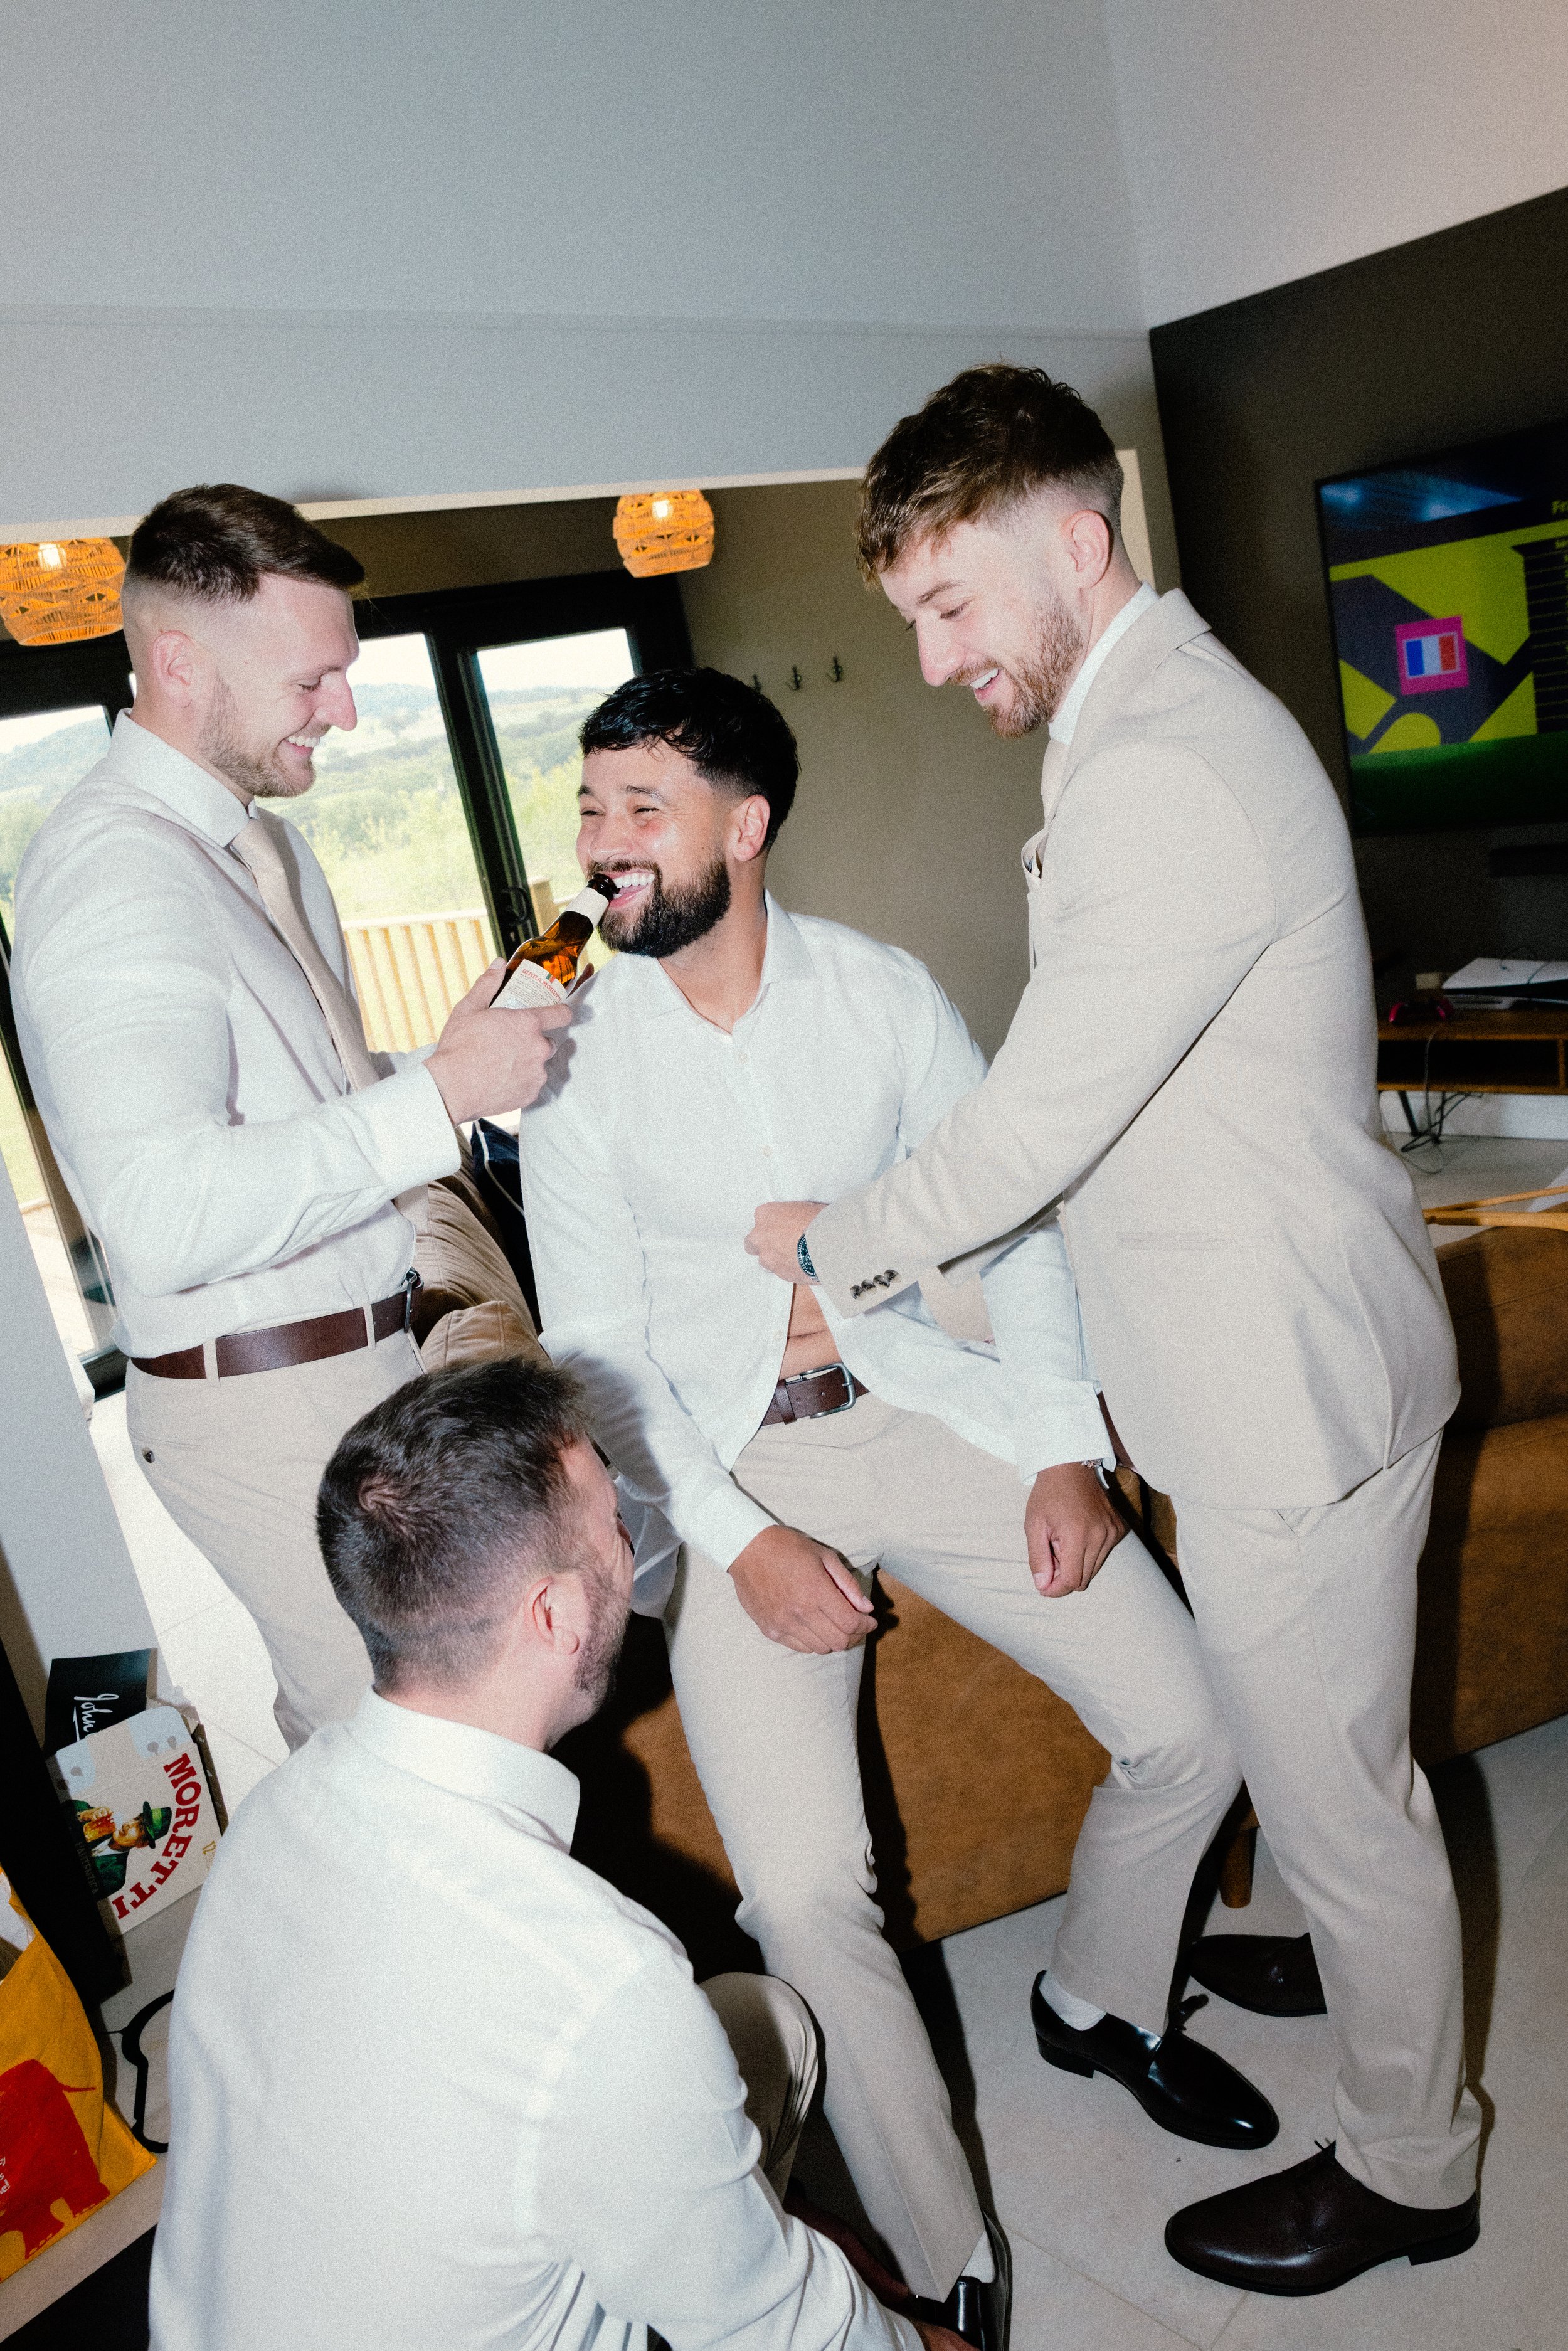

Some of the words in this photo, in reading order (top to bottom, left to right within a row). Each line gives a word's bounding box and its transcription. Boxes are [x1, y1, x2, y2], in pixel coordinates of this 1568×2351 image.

[521, 968, 542, 984] BIRRA
[73, 1693, 120, 1733] John
[112, 1753, 202, 1919] MORETTI
[202, 1840, 217, 1855] 12
